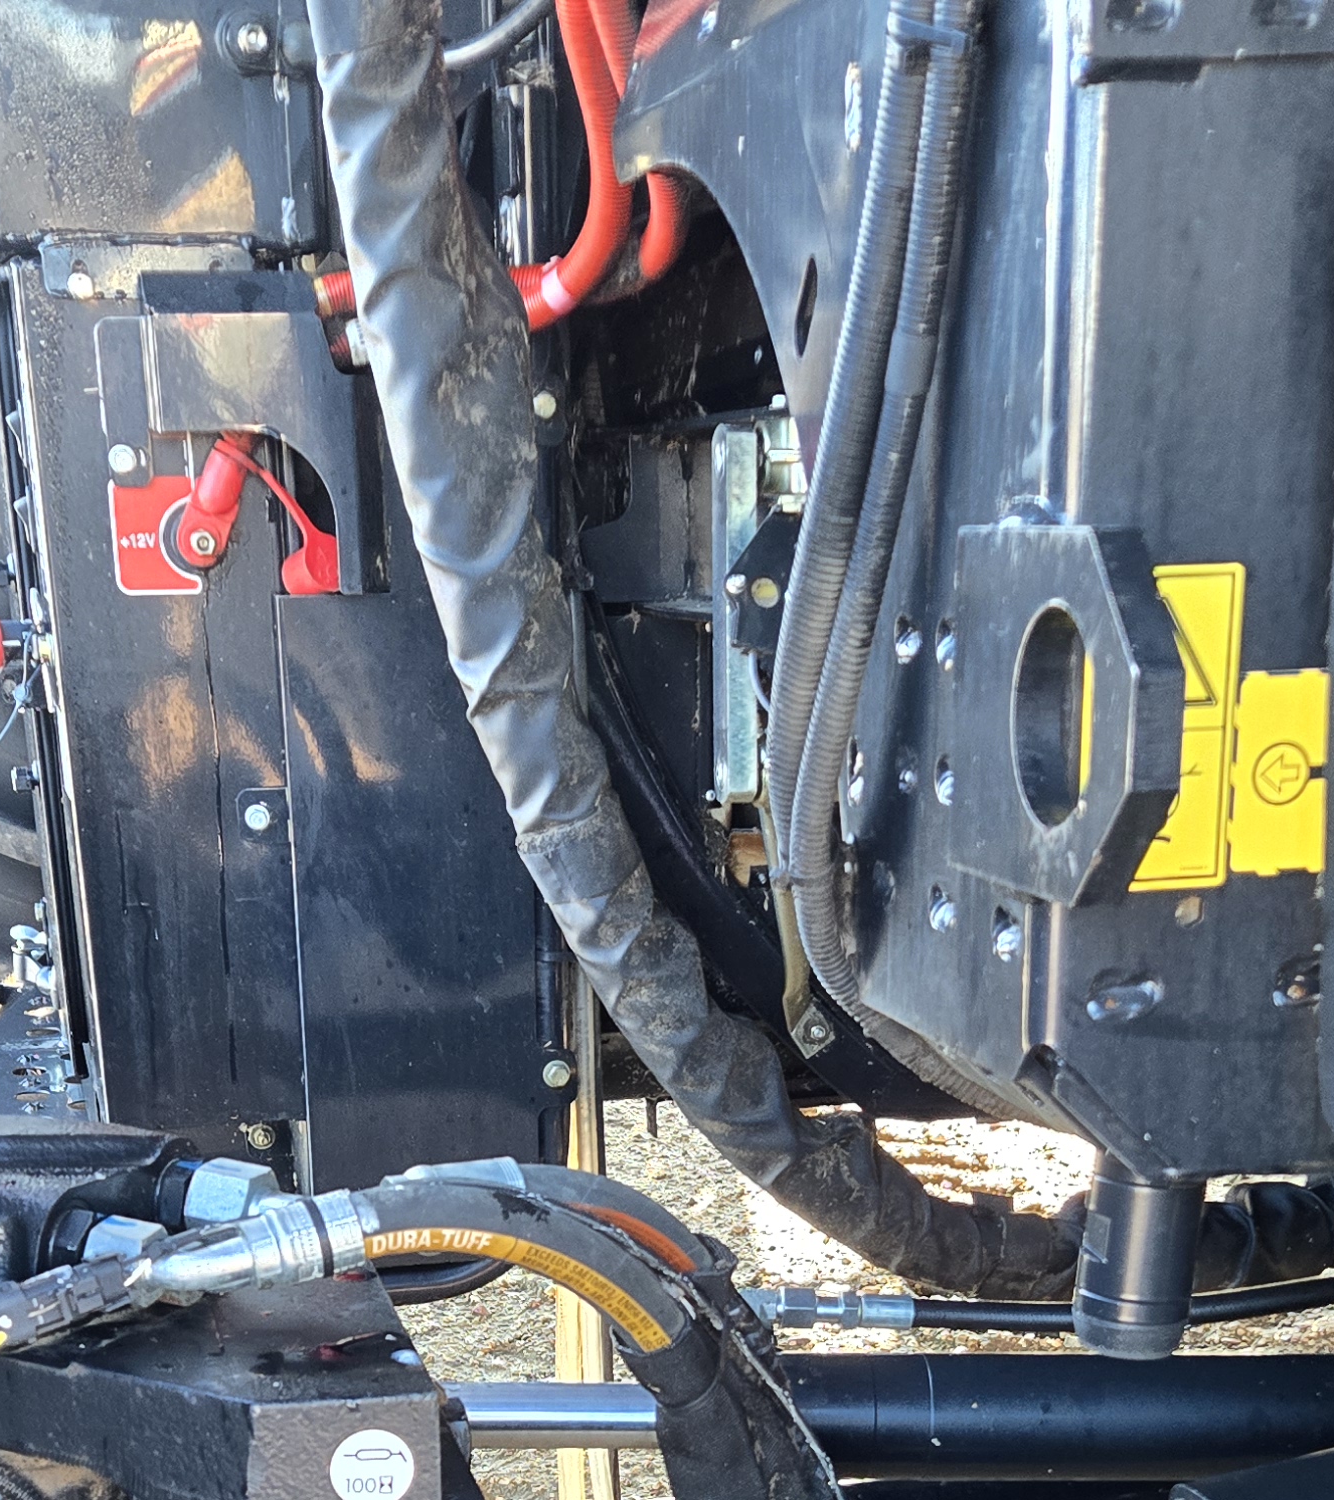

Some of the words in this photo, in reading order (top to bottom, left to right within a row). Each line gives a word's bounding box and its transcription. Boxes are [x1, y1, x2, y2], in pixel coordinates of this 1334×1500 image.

[120, 532, 156, 549] +12V
[371, 1229, 494, 1254] DURA-TUFF
[526, 1246, 571, 1269] EXCEEDS
[346, 1478, 376, 1493] 100
